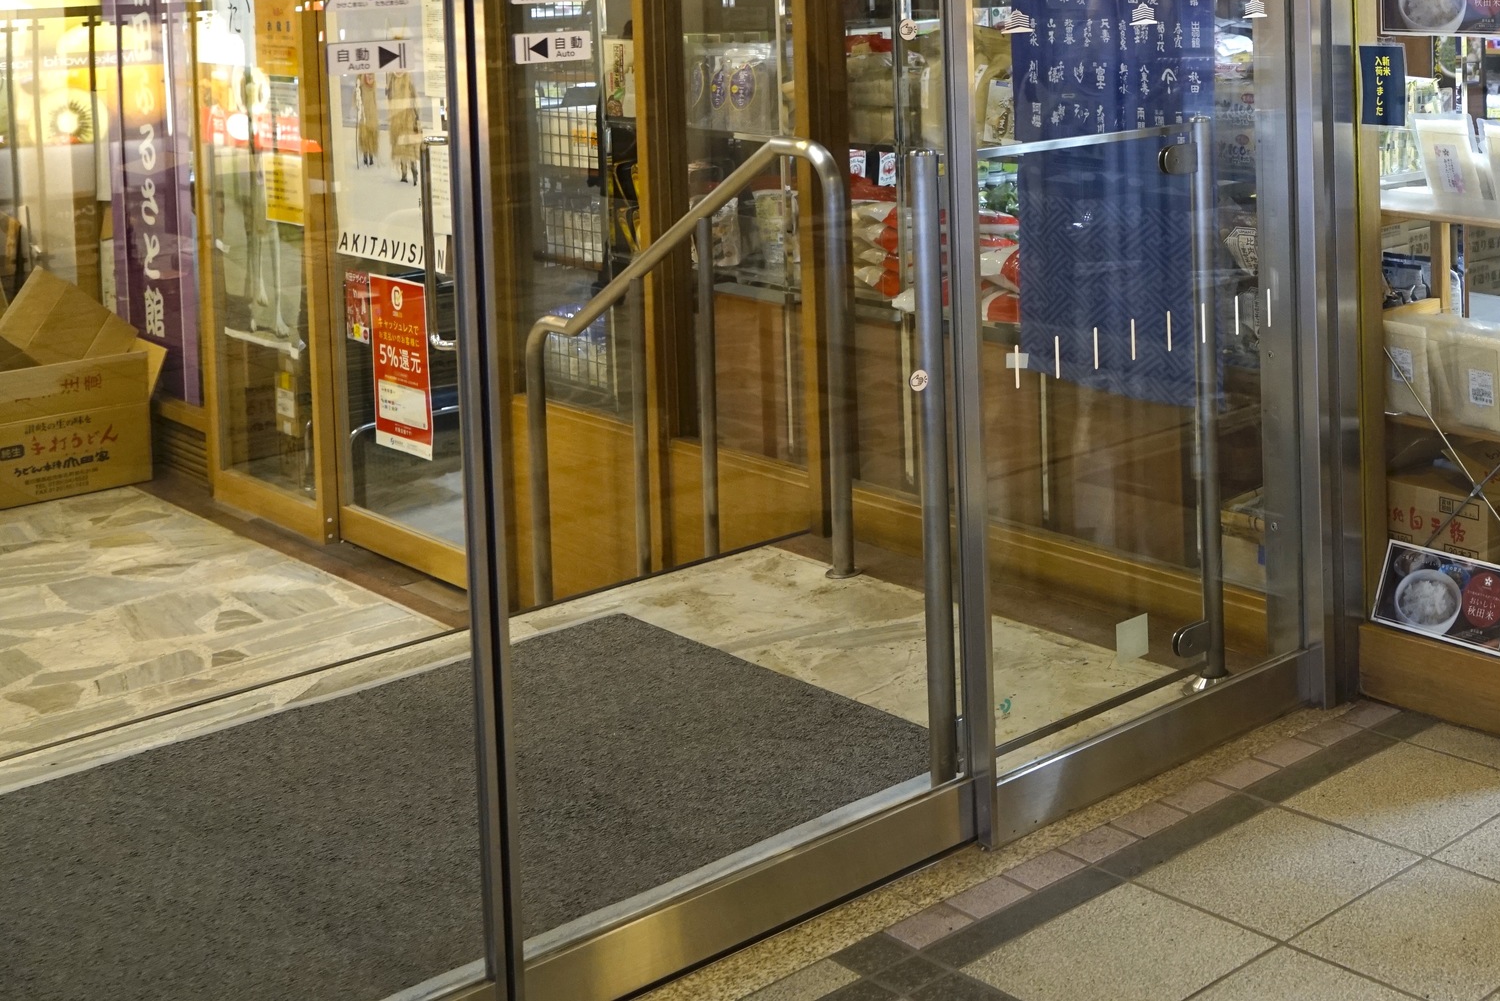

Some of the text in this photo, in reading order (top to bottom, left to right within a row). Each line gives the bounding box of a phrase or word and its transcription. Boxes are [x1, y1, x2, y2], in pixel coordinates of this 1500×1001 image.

[555, 36, 583, 50] 自動
[337, 47, 370, 63] 自動
[556, 50, 575, 58] Auto
[348, 62, 371, 71] Auto
[1381, 56, 1391, 77] 新米
[1374, 55, 1384, 117] 入荷しました
[339, 231, 444, 270] AKITAVISIN
[379, 343, 422, 374] 5%還元
[1469, 597, 1496, 609] おいしい
[1467, 605, 1495, 621] 秋田米
